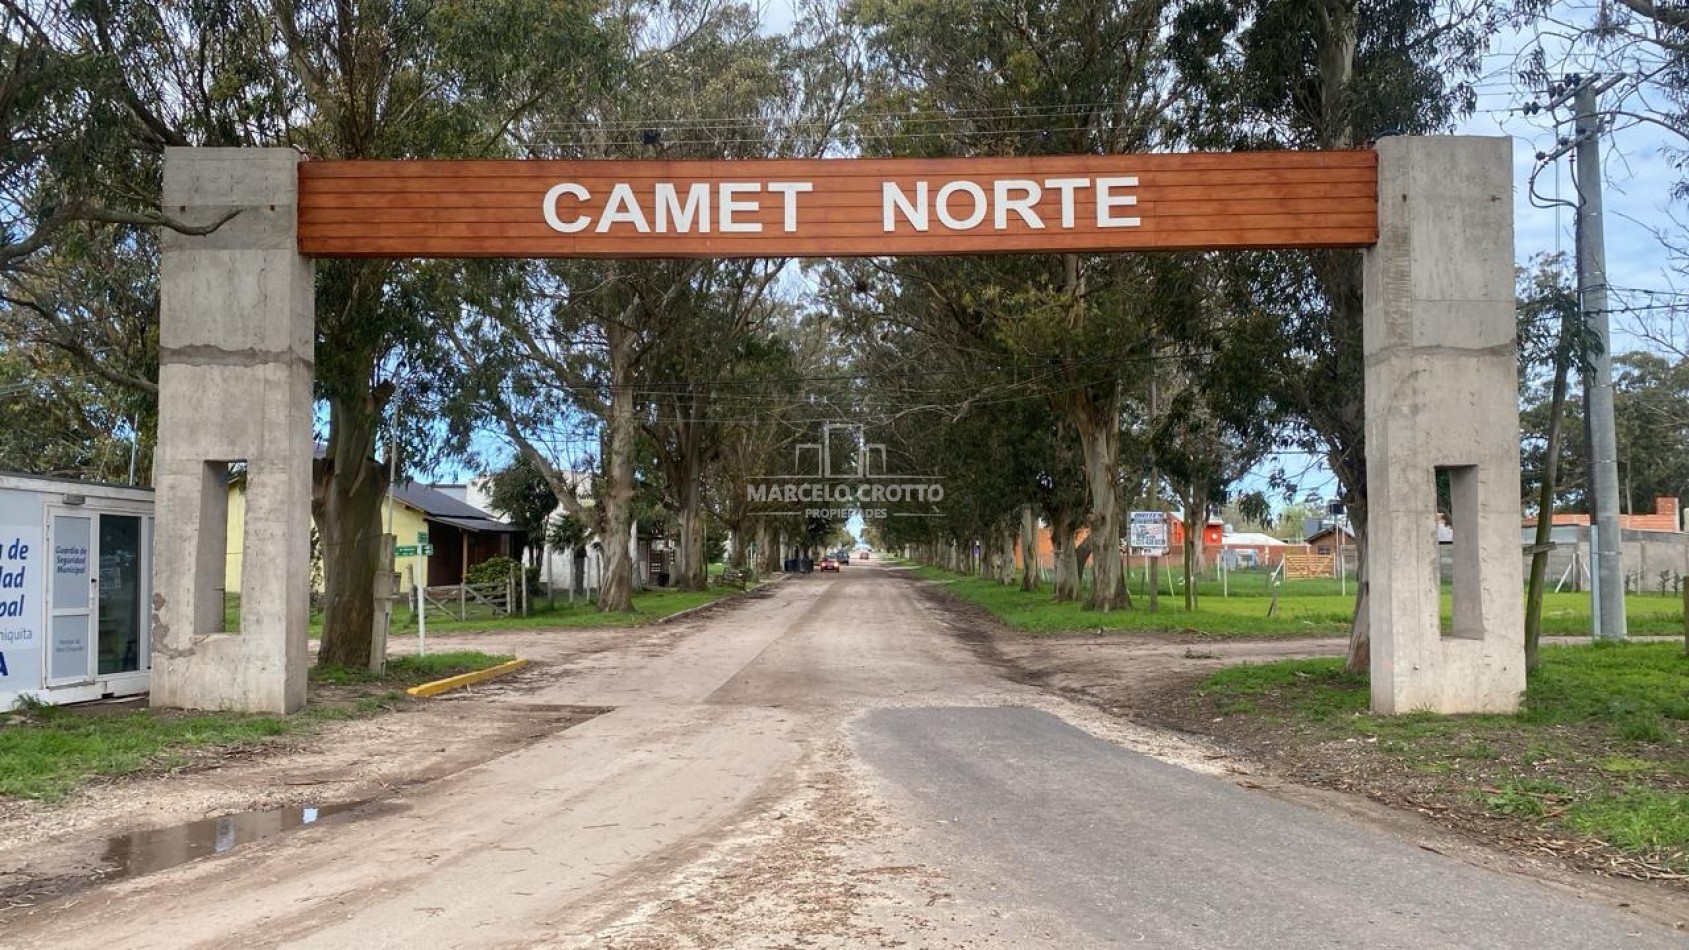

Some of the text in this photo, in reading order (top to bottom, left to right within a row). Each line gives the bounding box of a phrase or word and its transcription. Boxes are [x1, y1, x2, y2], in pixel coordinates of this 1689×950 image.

[541, 176, 1141, 234] CAMET NORTE
[8, 538, 29, 560] de
